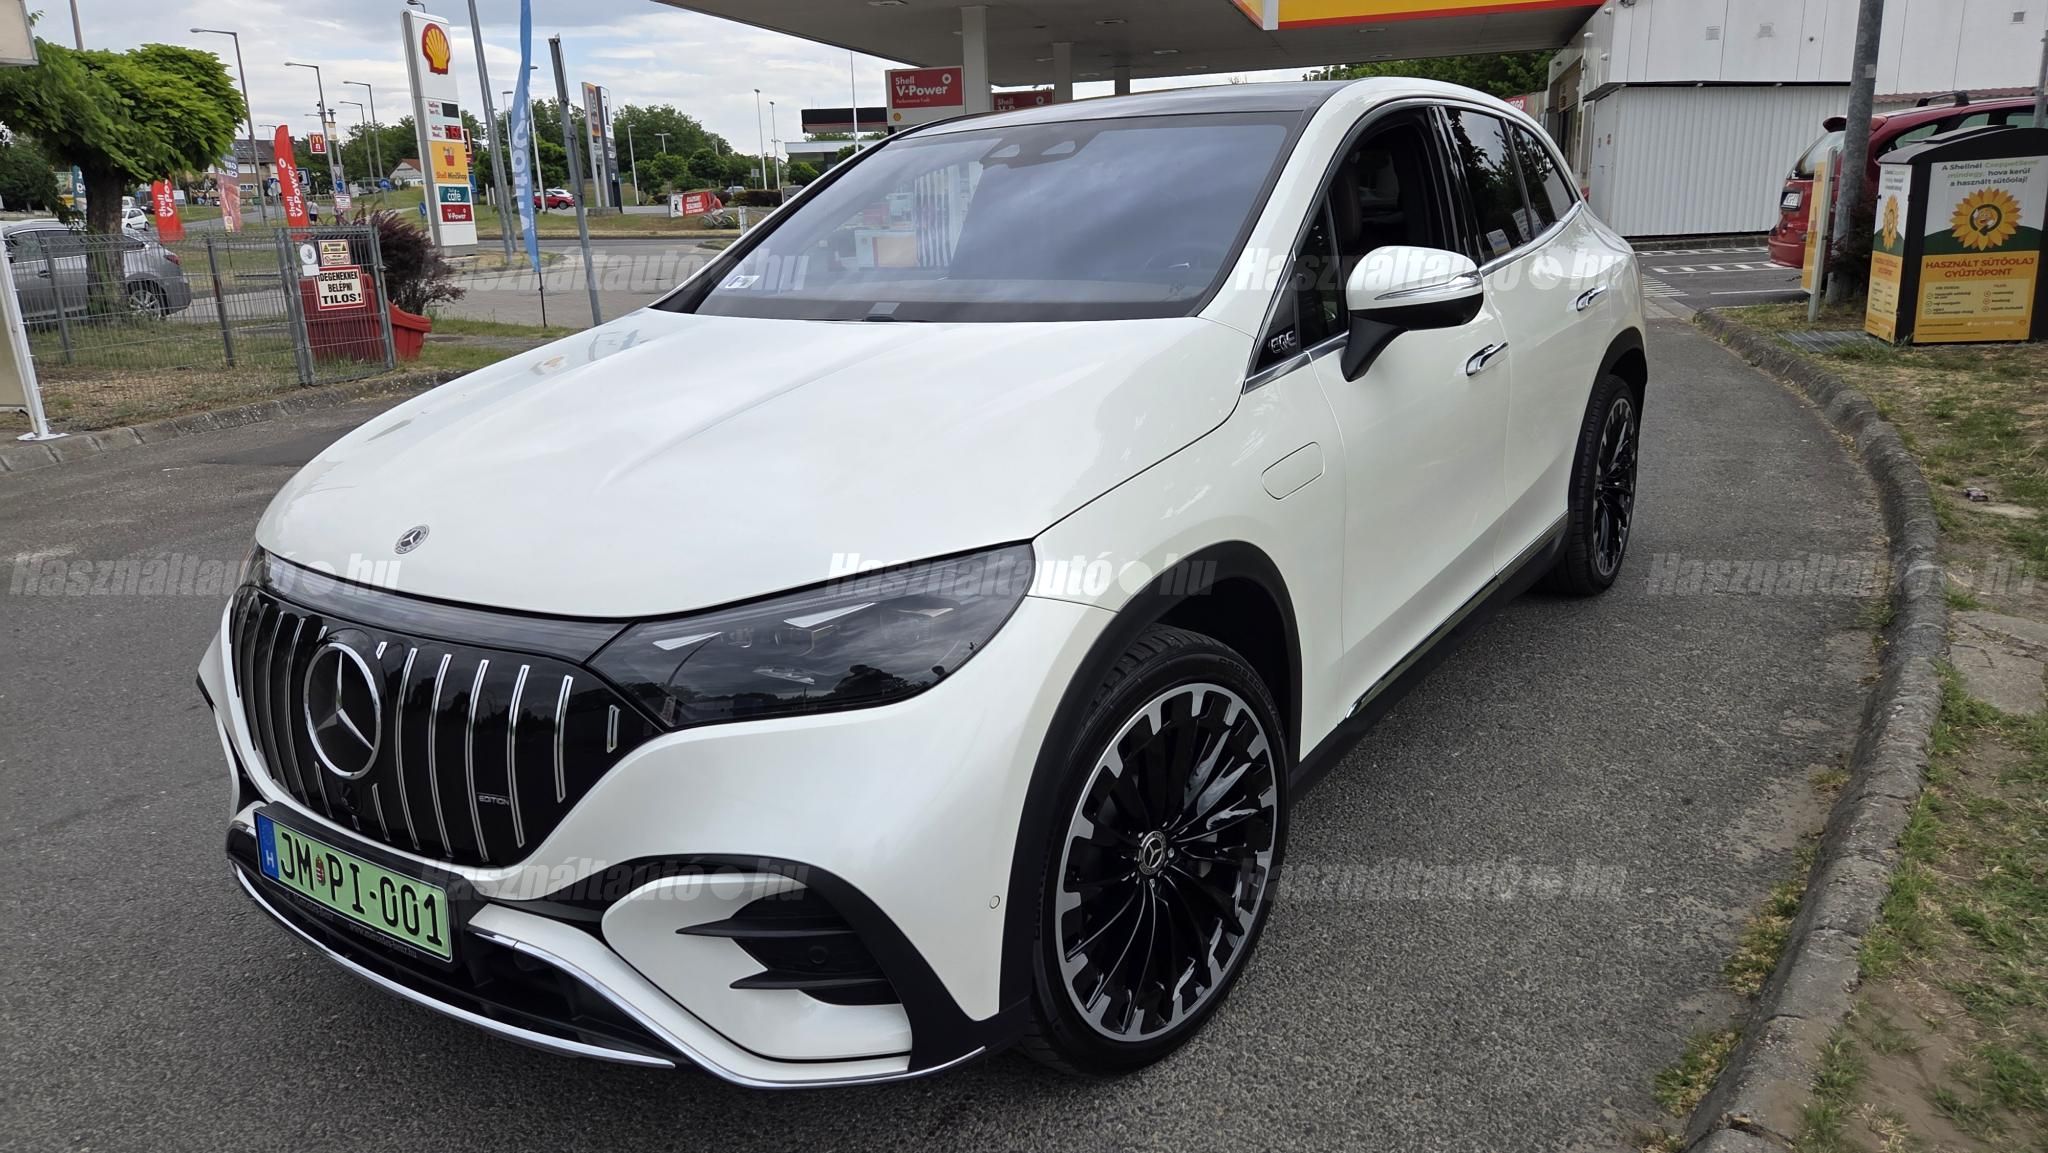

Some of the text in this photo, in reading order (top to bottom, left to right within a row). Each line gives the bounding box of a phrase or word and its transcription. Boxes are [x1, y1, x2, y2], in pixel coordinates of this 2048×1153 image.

[895, 76, 915, 86] Shell
[897, 85, 948, 97] V-Power
[997, 98, 1014, 106] Shell
[1987, 169, 2008, 177] hova
[287, 163, 303, 217] V-Power
[157, 194, 167, 217] Shell
[287, 196, 297, 218] Shell
[1925, 258, 1980, 269] HASZNÁLT
[328, 280, 353, 293] BELÉPNI
[266, 851, 275, 867] H
[280, 831, 444, 948] JM PI-001
